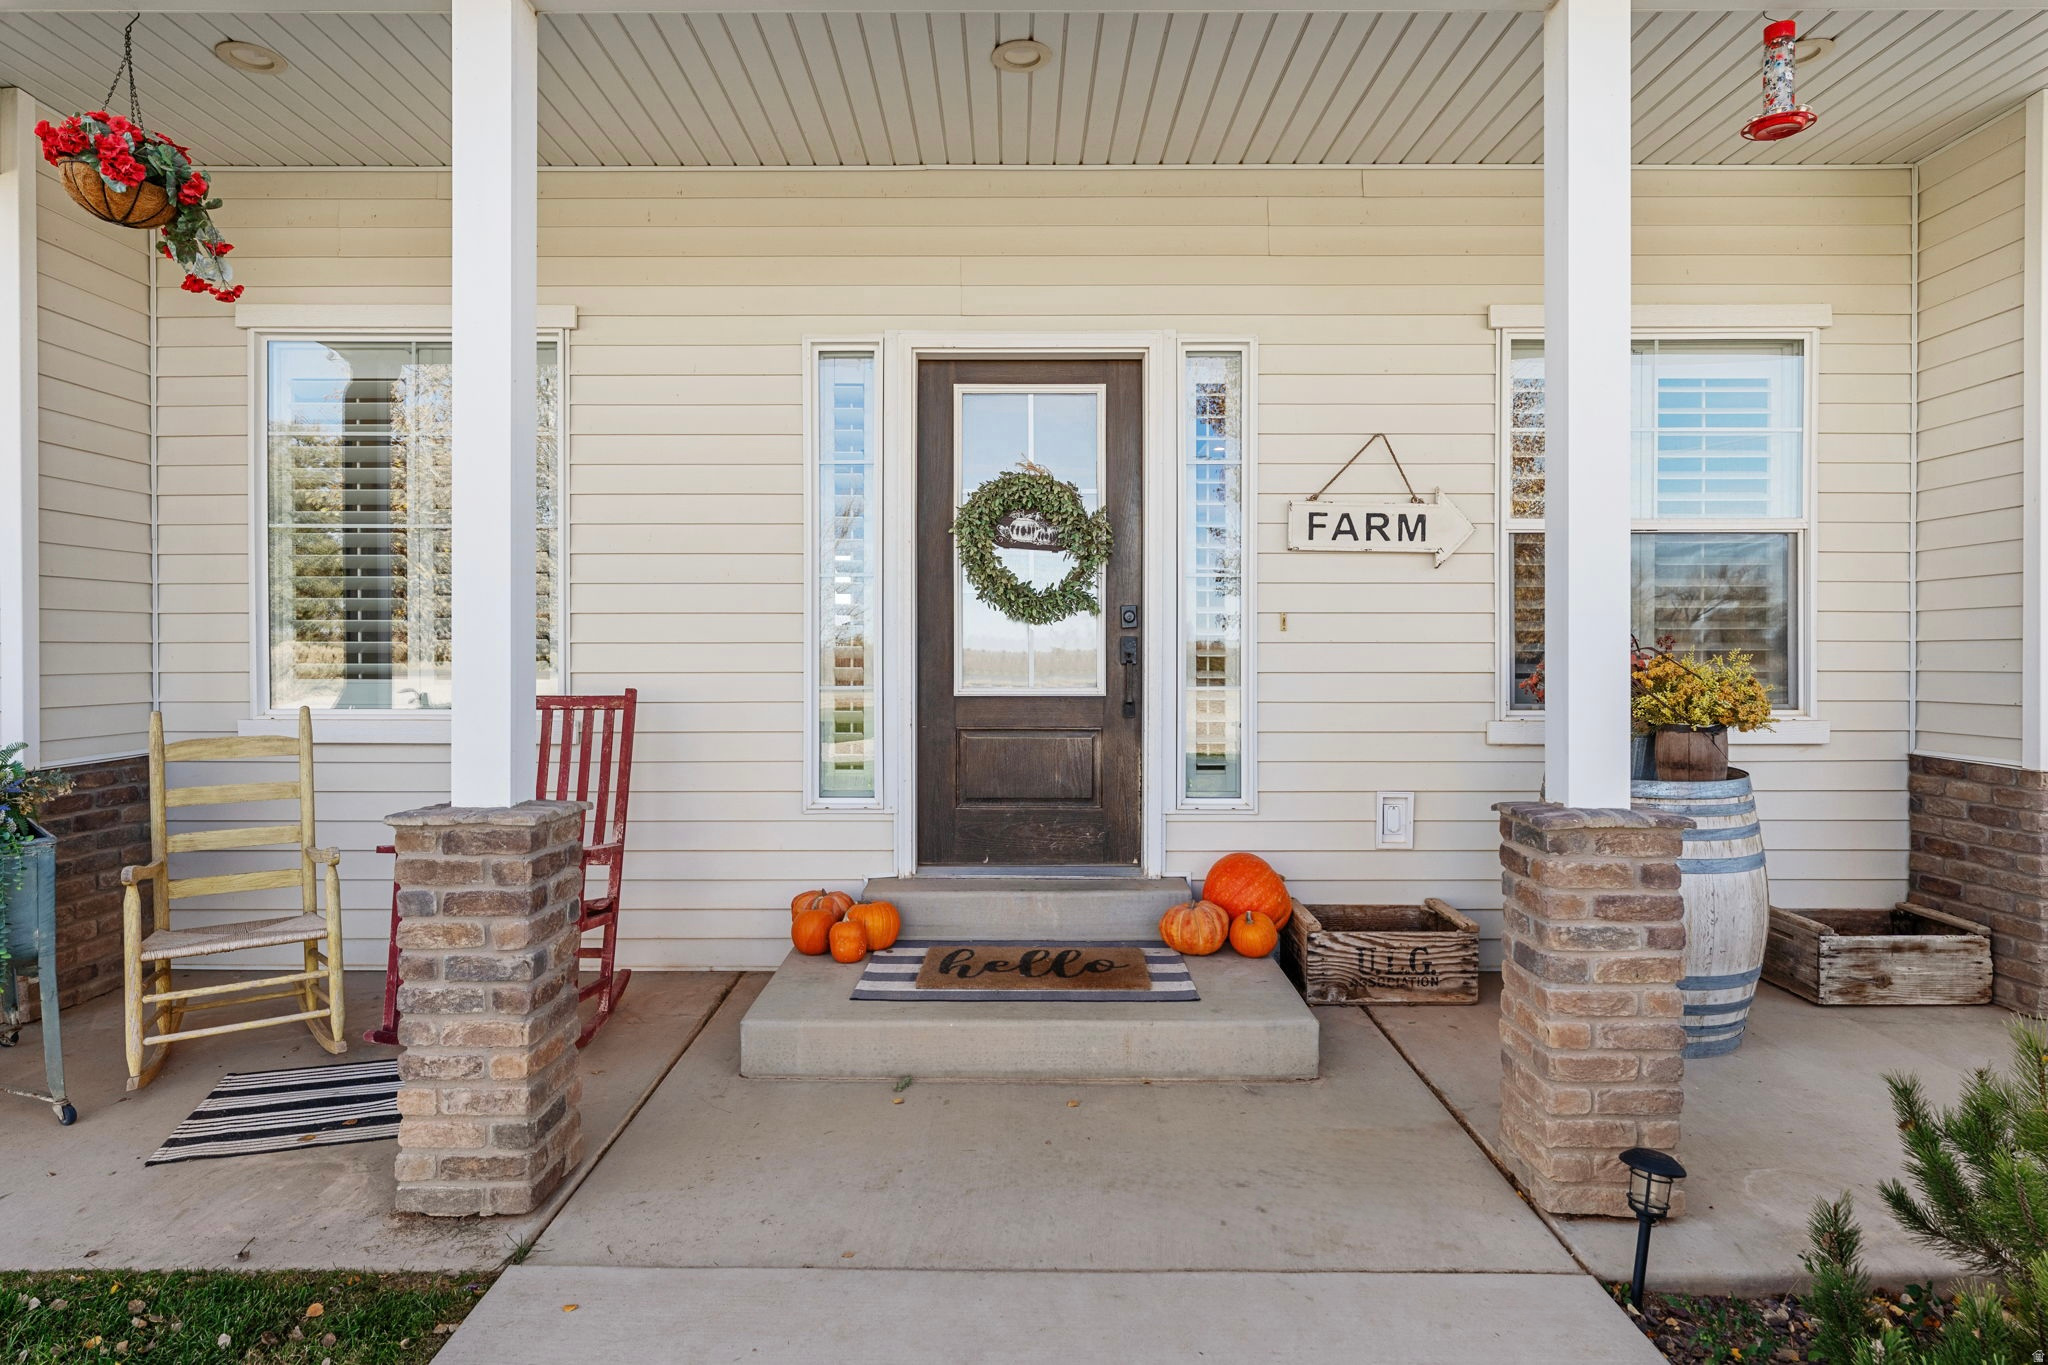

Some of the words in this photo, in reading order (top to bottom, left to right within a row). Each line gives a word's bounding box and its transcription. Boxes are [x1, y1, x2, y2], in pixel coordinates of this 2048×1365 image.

[1308, 512, 1427, 542] FARM
[939, 948, 1130, 979] hello
[1349, 976, 1439, 989] ASSOCIATION
